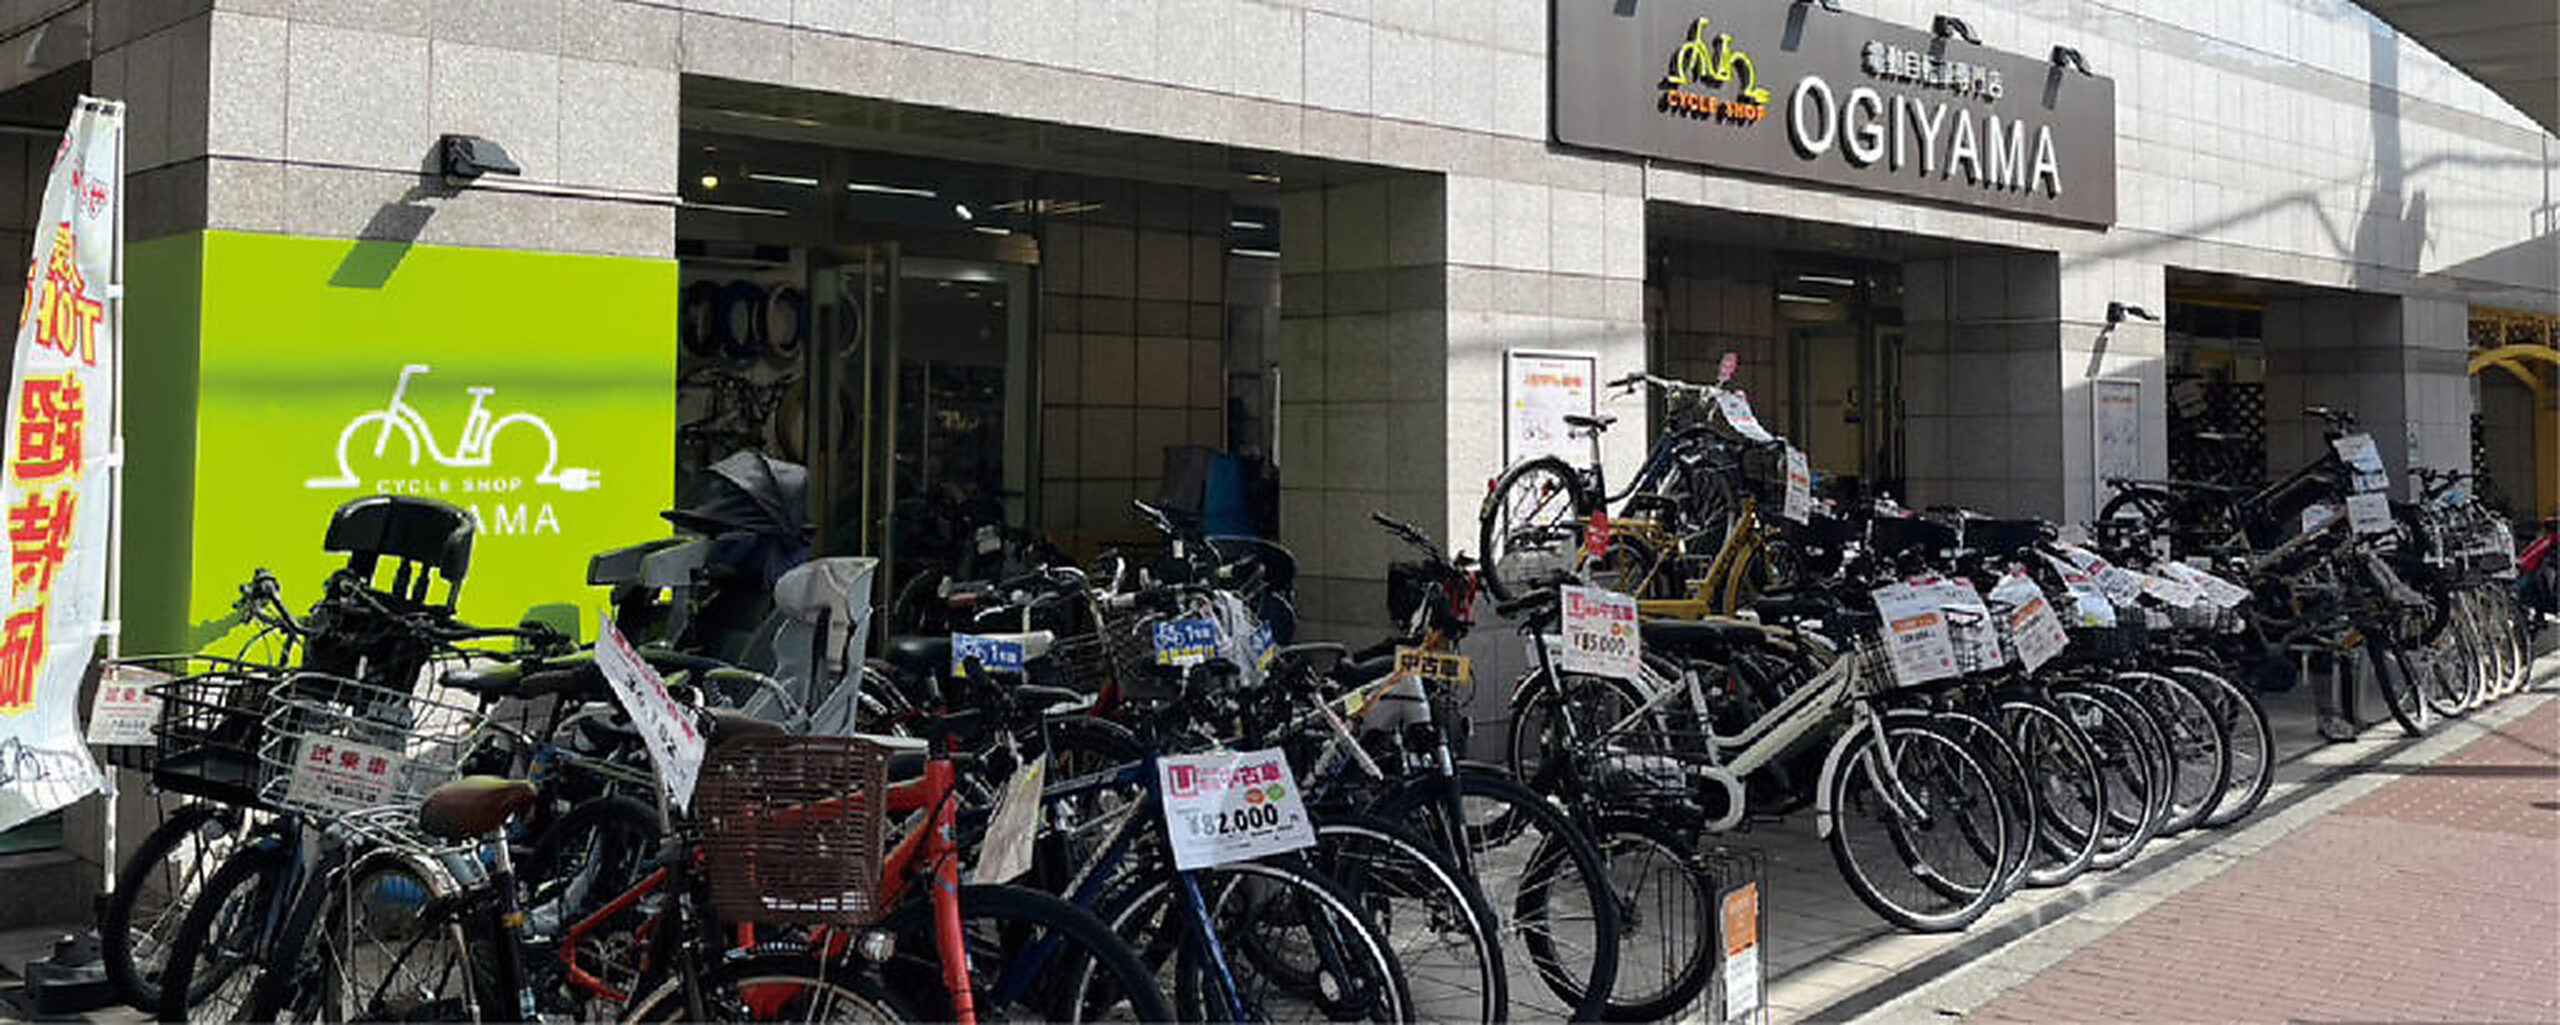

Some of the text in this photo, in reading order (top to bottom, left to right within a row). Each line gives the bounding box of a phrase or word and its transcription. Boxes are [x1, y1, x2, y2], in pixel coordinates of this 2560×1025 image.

[1667, 90, 1768, 122] CYCLE SHOP
[1793, 75, 2063, 195] OGIYAMA
[377, 477, 523, 494] CYCLE SHOP
